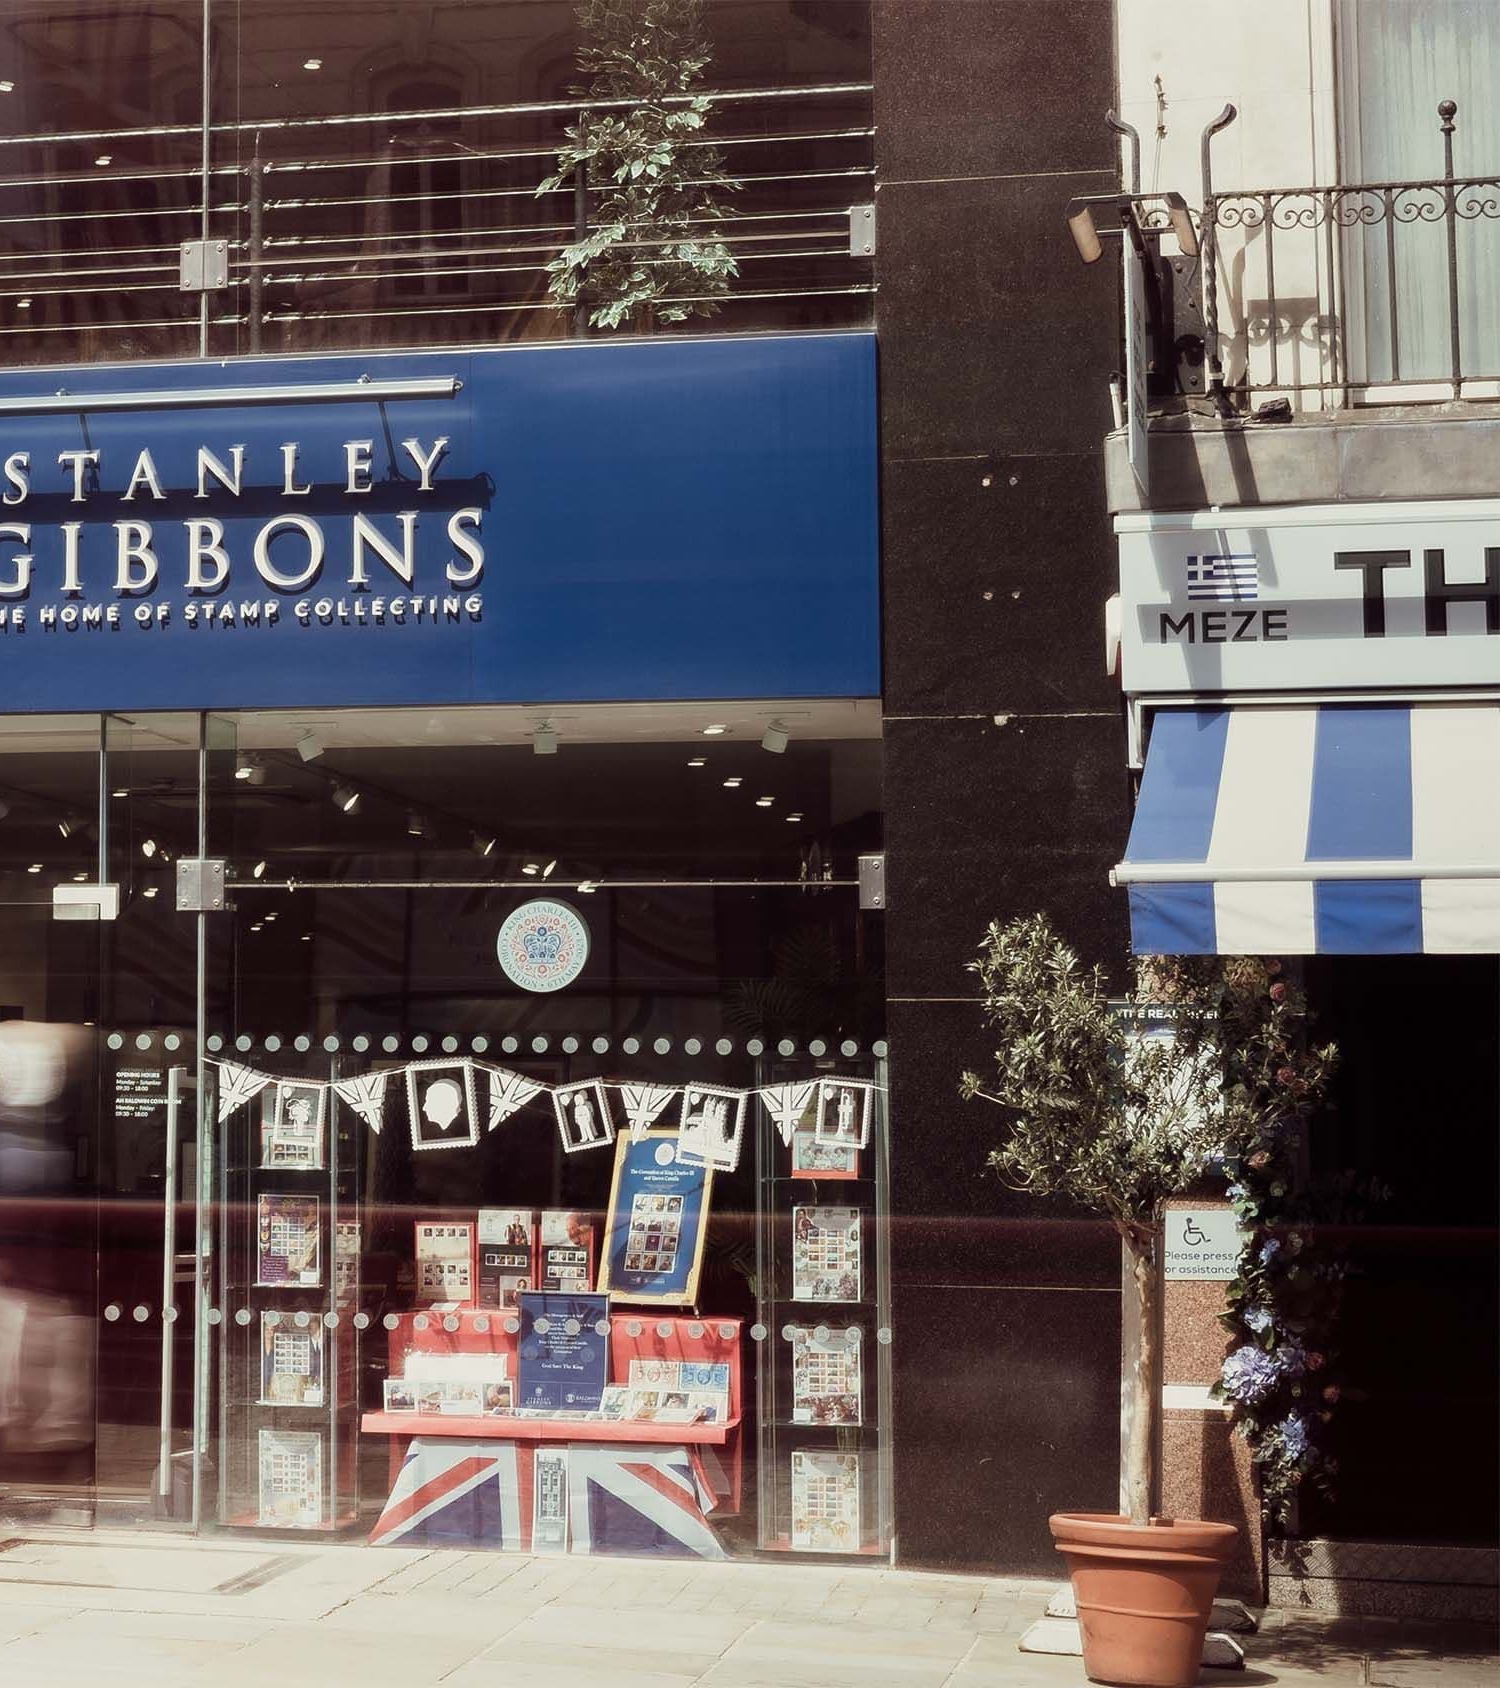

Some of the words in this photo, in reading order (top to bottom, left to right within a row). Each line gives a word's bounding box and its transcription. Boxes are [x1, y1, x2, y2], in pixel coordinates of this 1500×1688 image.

[2, 436, 448, 505] STANLEY
[1334, 546, 1500, 638] TH
[40, 604, 119, 623] HOME
[134, 604, 169, 621] OF
[185, 601, 277, 620] STAMP
[295, 596, 482, 618] COLLECTING
[1160, 609, 1288, 644] MEZE
[1165, 1251, 1200, 1260] Please
[1203, 1253, 1233, 1262] press
[1179, 1265, 1236, 1273] assistance
